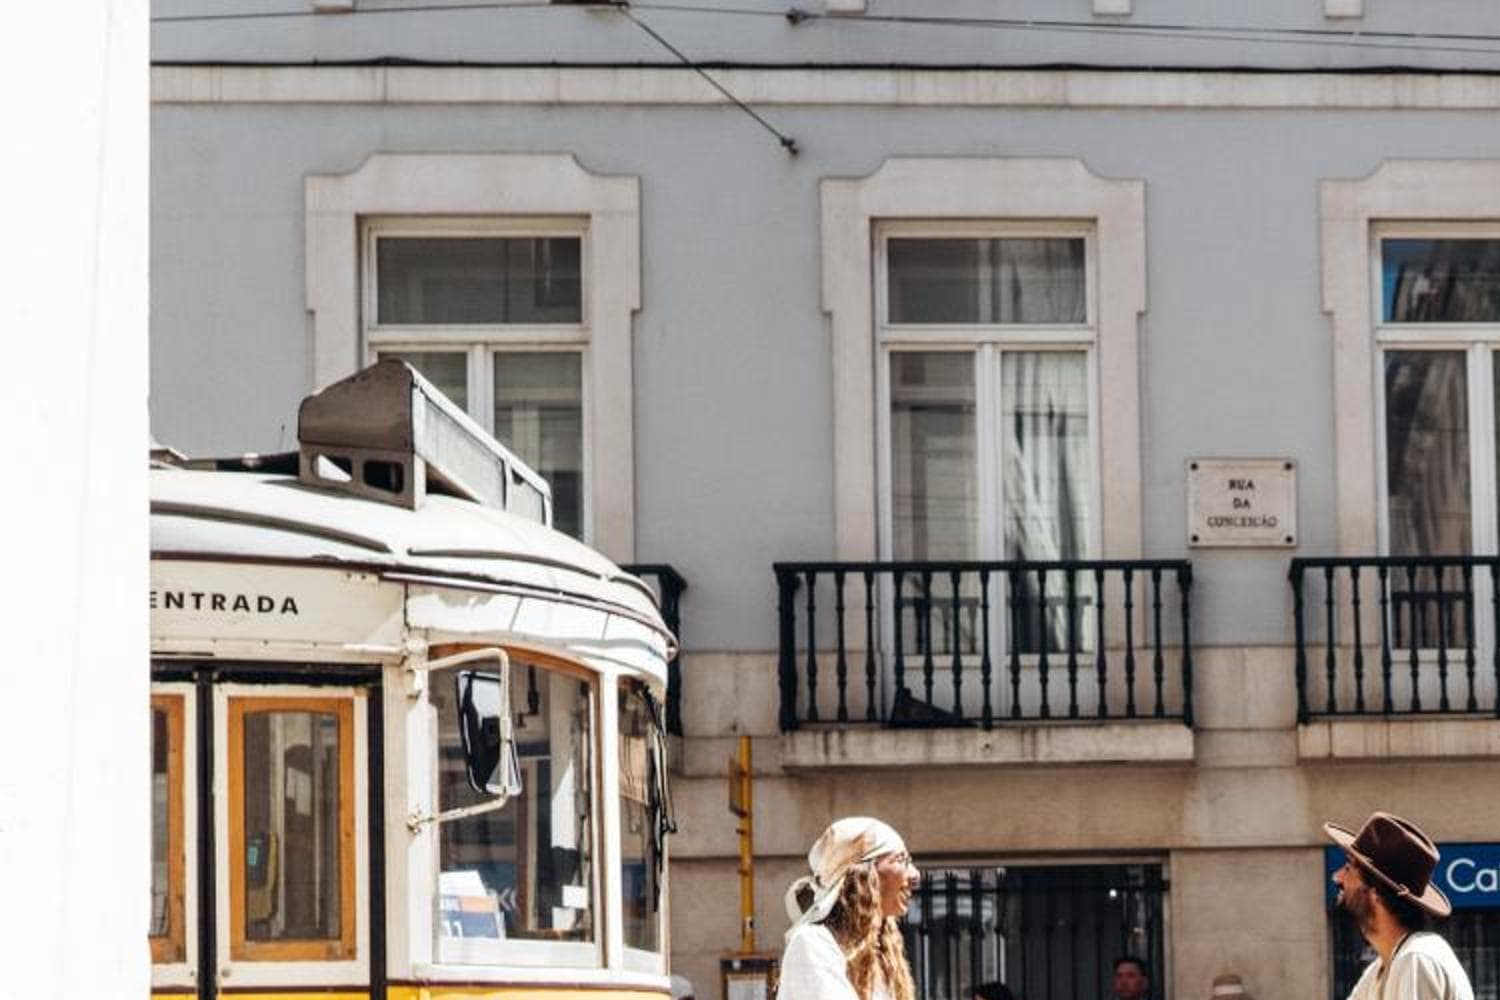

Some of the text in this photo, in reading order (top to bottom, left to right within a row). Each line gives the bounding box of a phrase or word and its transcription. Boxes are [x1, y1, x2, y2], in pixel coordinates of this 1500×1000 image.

[1228, 479, 1255, 491] RUA
[1233, 497, 1251, 510] DA
[149, 590, 299, 615] ENTRADA
